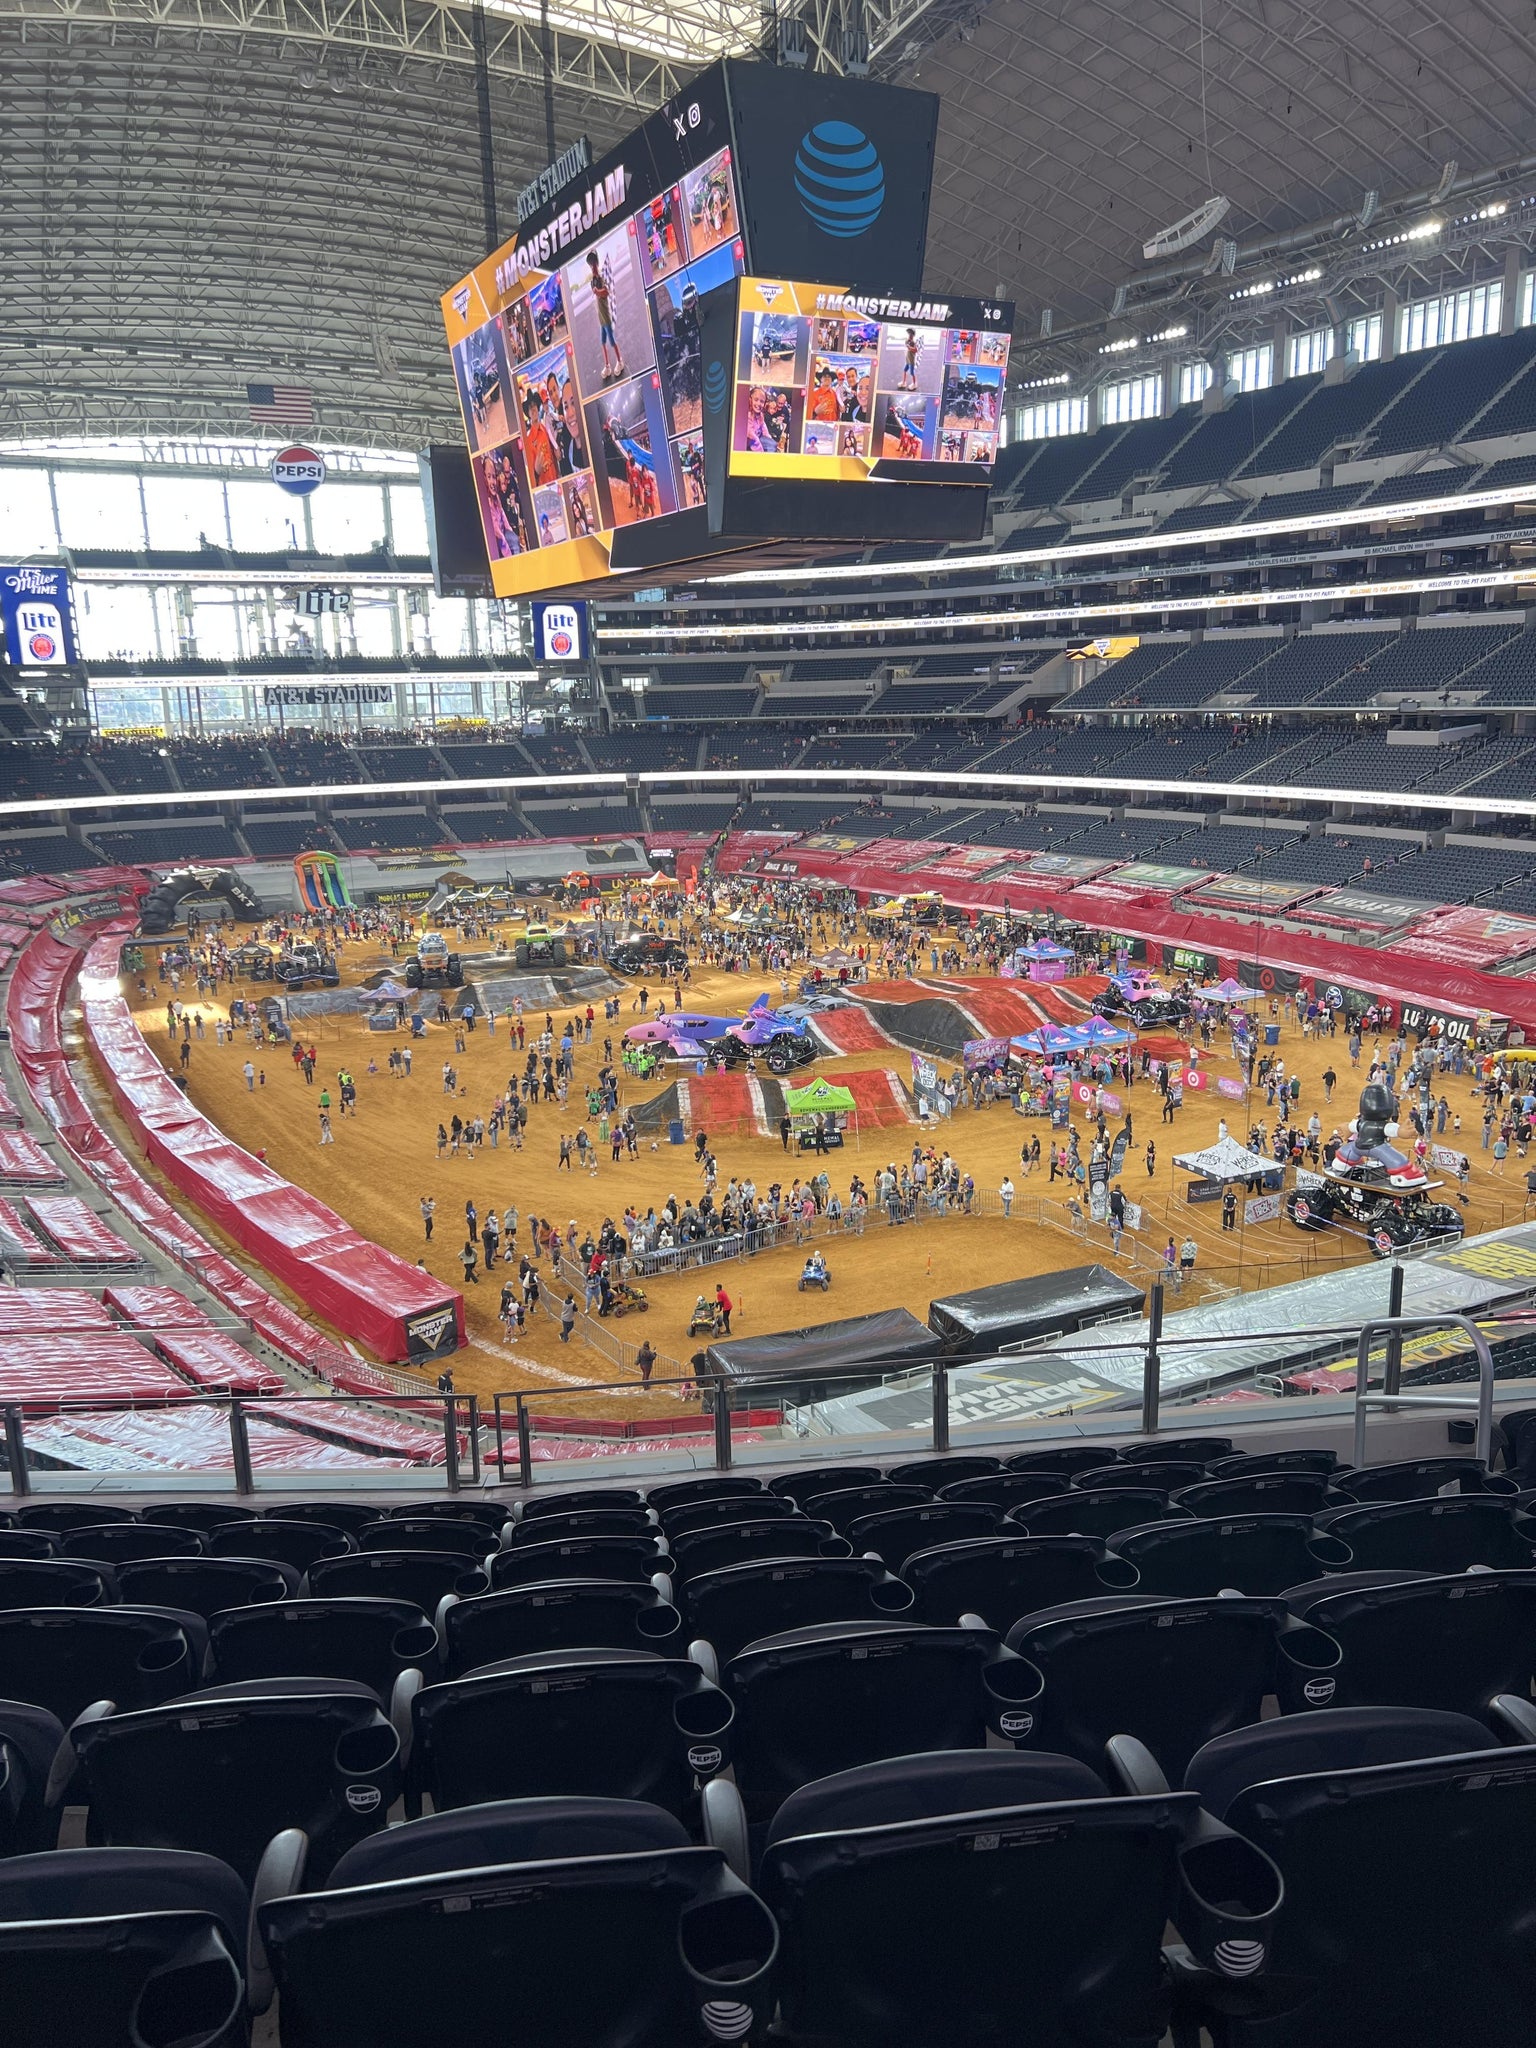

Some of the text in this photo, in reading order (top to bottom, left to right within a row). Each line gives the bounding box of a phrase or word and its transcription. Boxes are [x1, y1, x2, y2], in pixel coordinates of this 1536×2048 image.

[516, 137, 589, 224] AT&T STADIUM
[495, 164, 626, 296] #MONSTERJAM
[815, 293, 949, 322] #MONSTERJAM
[276, 465, 322, 477] PEPSI
[1496, 532, 1512, 540] TROY
[1372, 546, 1397, 554] MICHAEL
[19, 568, 41, 578] IT'S
[5, 574, 59, 594] Miller
[31, 586, 58, 594] TIME
[295, 587, 350, 619] Lite
[22, 612, 56, 631] Lite
[547, 614, 574, 630] Lite
[266, 686, 391, 705] AT&T STADIUM
[1117, 863, 1201, 880] BKT
[1223, 881, 1267, 893] JCB
[231, 887, 255, 908] BKT
[407, 891, 430, 900] MORGAN
[1323, 896, 1420, 916] LUCAS OIL
[1174, 949, 1205, 968] BKT
[1447, 1020, 1470, 1041] OIL
[974, 1044, 1009, 1059] SMASH
[408, 1315, 453, 1337] MONSTER
[423, 1326, 442, 1338] JAM
[907, 1376, 1101, 1429] MONSTER
[1305, 1686, 1335, 1696] PEPSI
[1002, 1719, 1032, 1729] PEPSI
[690, 1753, 721, 1764] PEPSI
[348, 1791, 380, 1803] PEPSI
